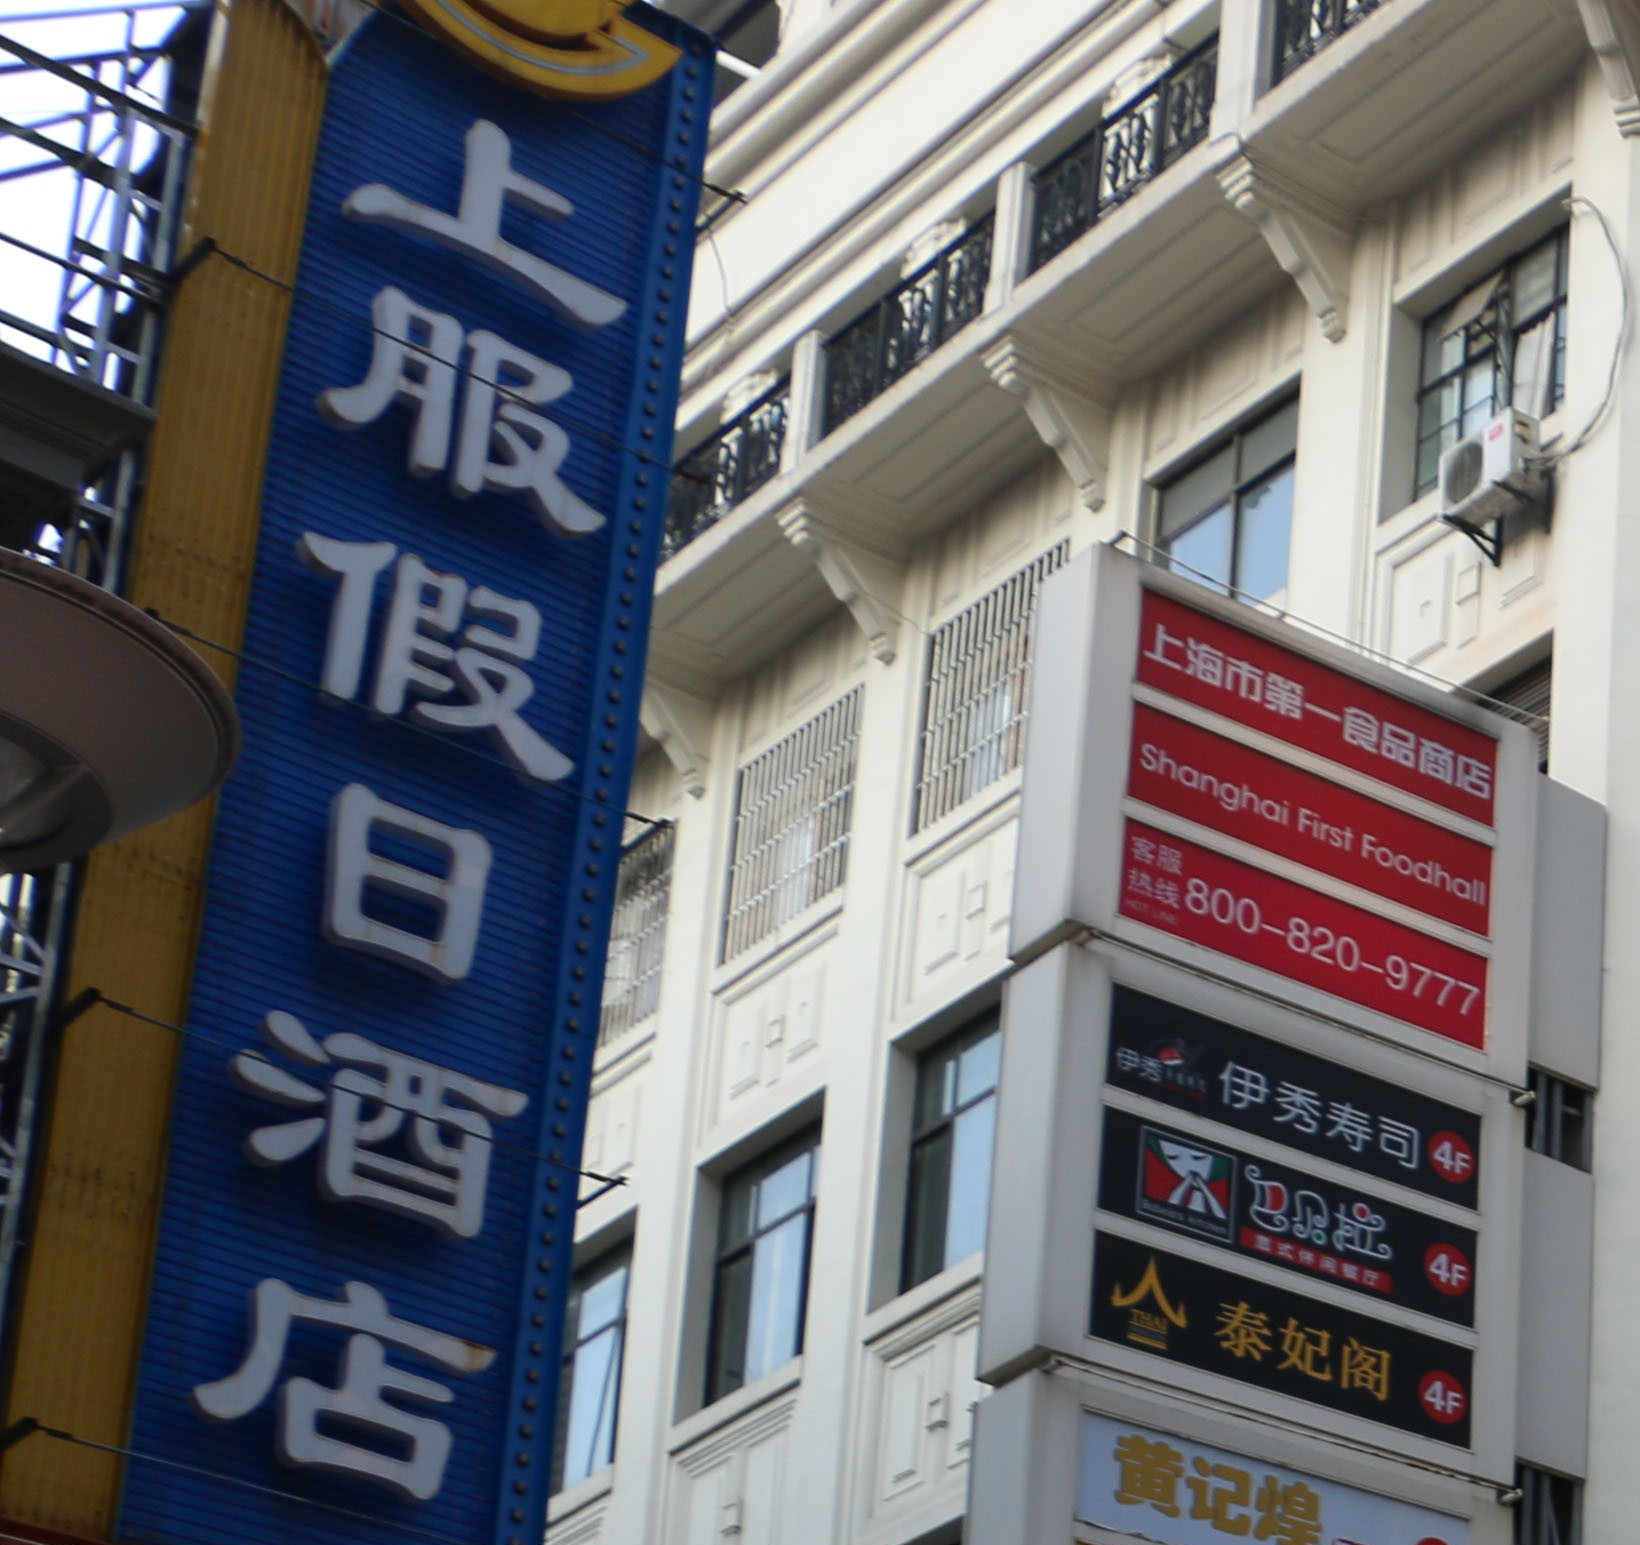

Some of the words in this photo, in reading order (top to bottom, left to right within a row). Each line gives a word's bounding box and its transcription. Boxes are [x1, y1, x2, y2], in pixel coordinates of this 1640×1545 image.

[1143, 624, 1492, 799] 上海市第一食品商店
[192, 118, 628, 1501] 上服假日酒店
[1131, 836, 1183, 877] 客服
[1139, 743, 1290, 826] Shanghai
[1297, 807, 1353, 853] First
[1361, 832, 1485, 906] Foodhall
[1127, 867, 1181, 909] 热线
[1184, 877, 1480, 1017] 800-820-9777
[1219, 1061, 1420, 1170] 伊秀寿司
[1433, 1141, 1472, 1175] 4F
[1429, 1253, 1467, 1287] 4F
[1214, 1301, 1391, 1401] 泰妃阁
[1424, 1381, 1462, 1414] 4F
